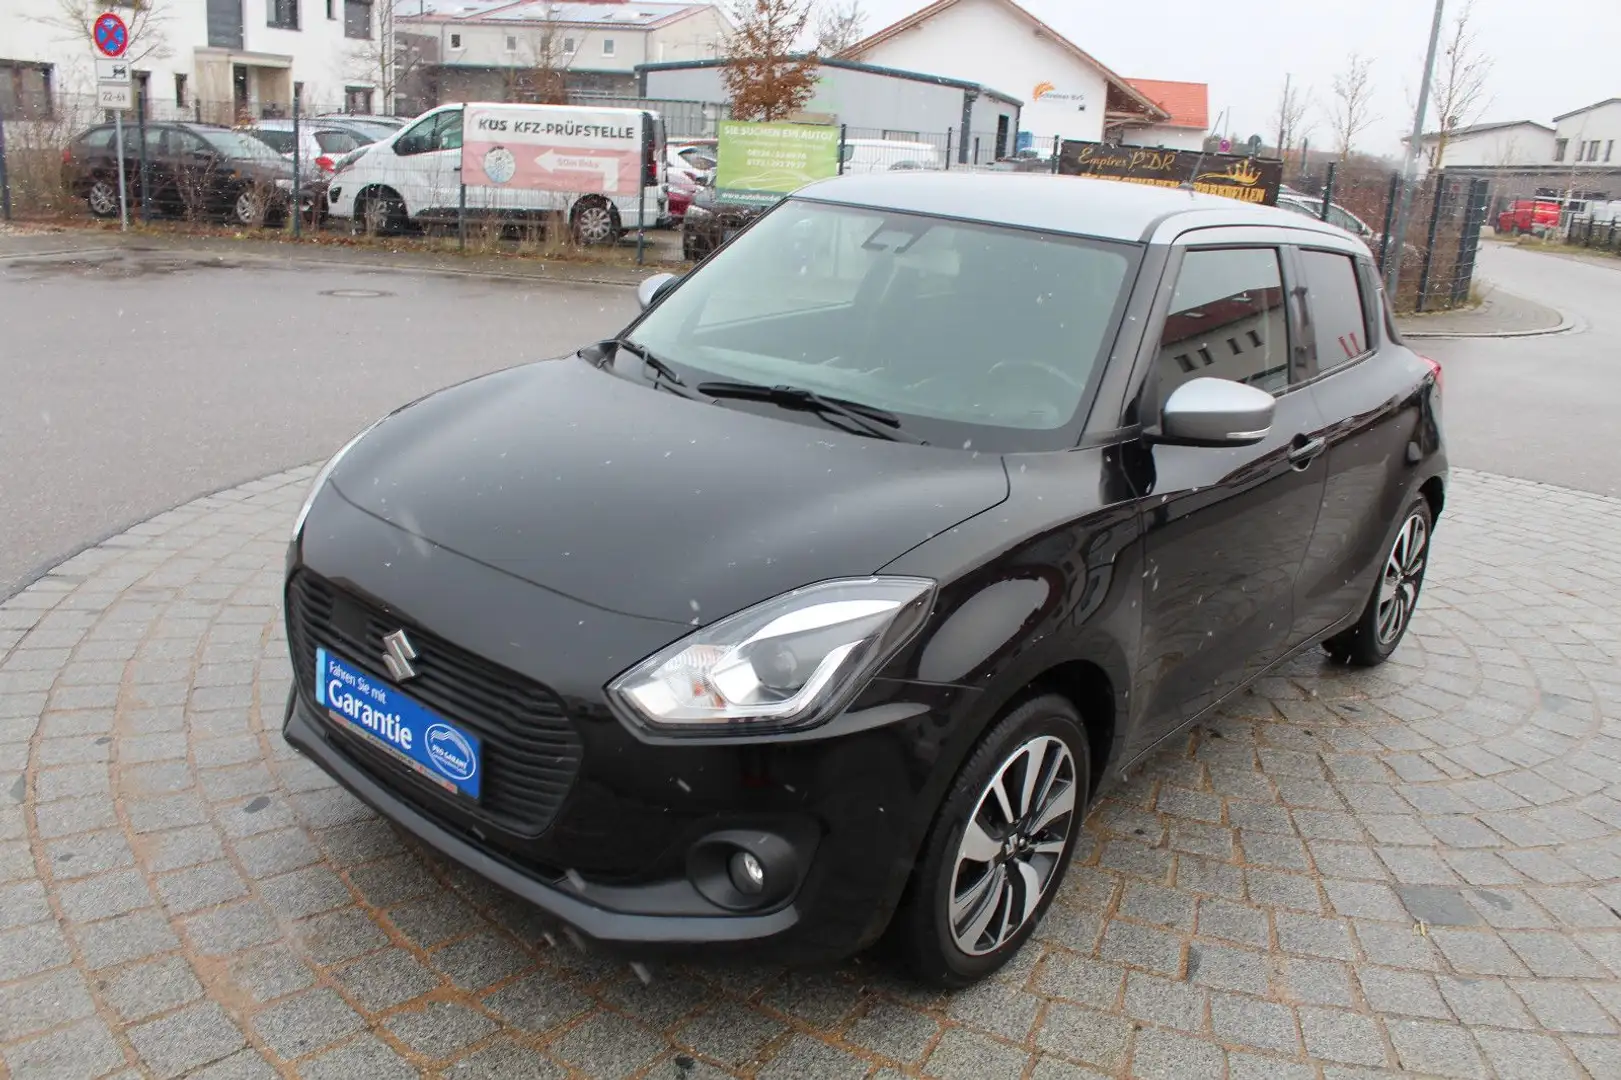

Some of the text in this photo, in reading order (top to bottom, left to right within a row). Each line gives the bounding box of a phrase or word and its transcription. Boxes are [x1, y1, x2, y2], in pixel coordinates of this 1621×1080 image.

[514, 120, 634, 139] KFZ-PRÜFSTELLE
[1128, 150, 1176, 171] PDR
[329, 660, 386, 704] Fahren Sie mit
[328, 679, 412, 750] Garantie
